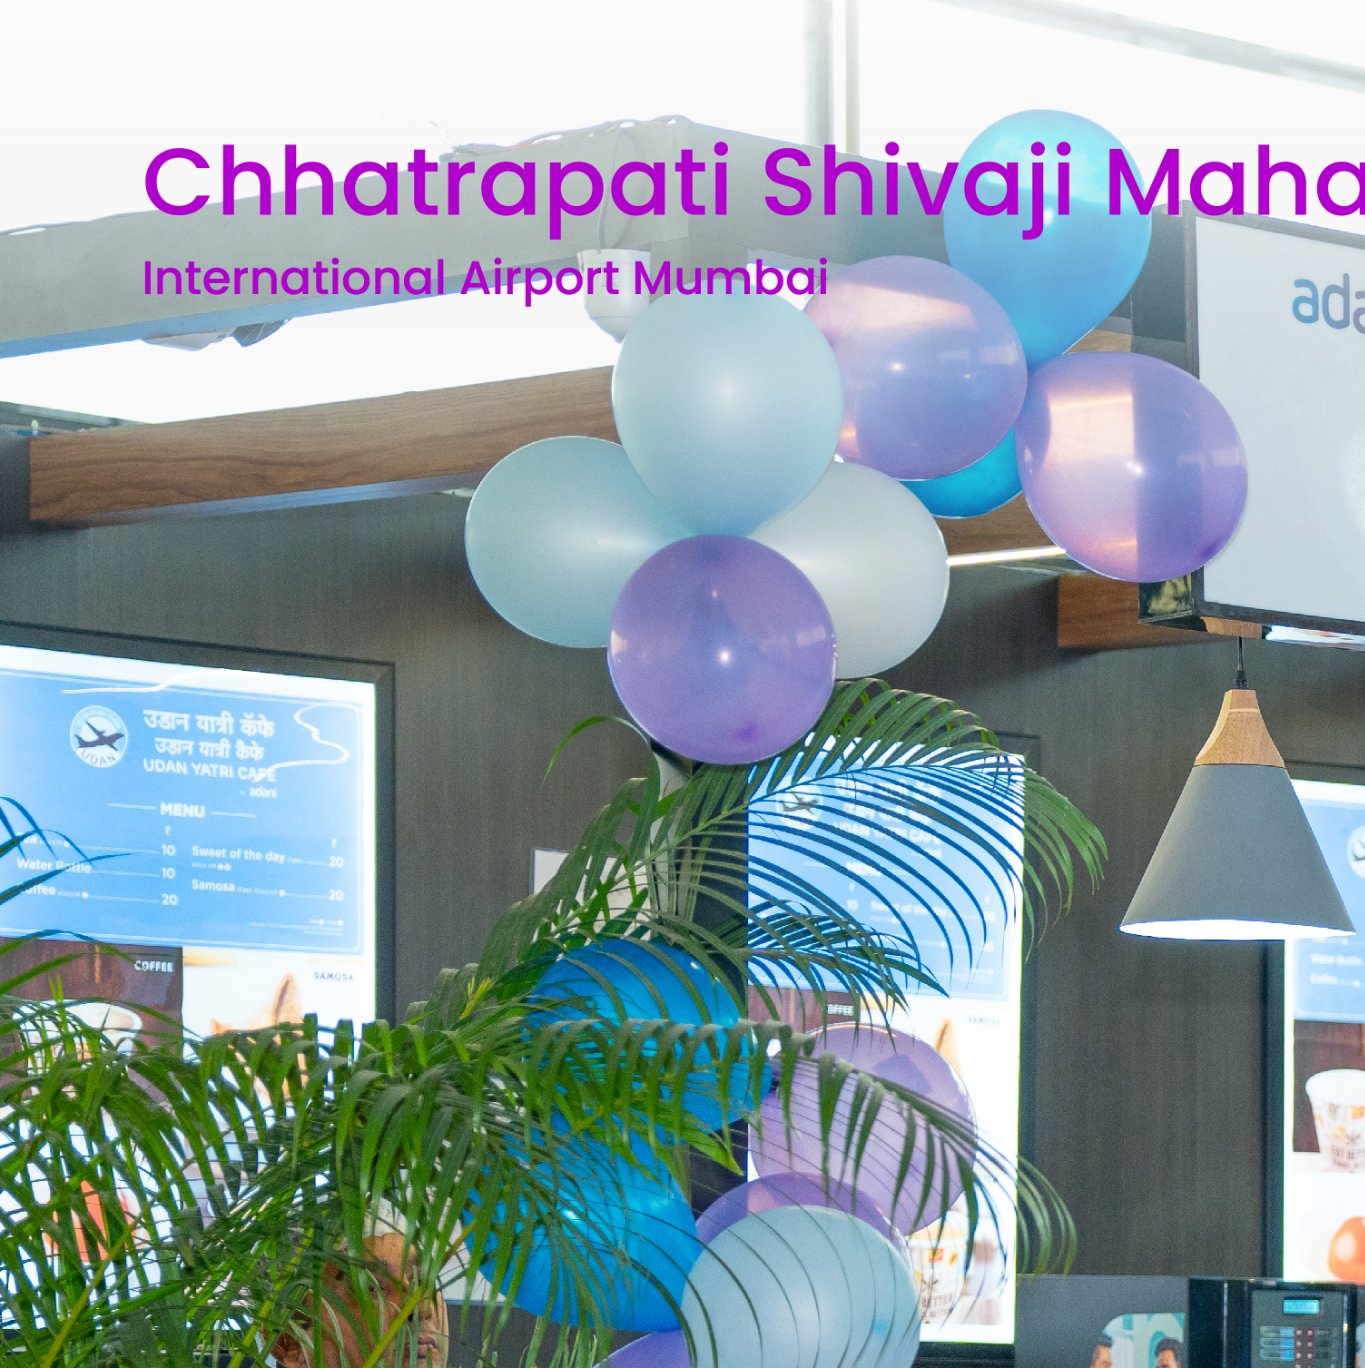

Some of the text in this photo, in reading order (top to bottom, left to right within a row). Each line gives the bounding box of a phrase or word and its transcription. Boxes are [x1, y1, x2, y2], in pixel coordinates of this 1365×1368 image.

[143, 758, 188, 776] UDAN
[191, 761, 233, 779] YATRI
[160, 801, 205, 820] MENU
[161, 845, 176, 857] 10
[191, 845, 227, 860] Sweet
[229, 846, 242, 860] of
[243, 848, 263, 862] the
[265, 850, 286, 865] day
[16, 857, 54, 872] Water
[328, 856, 345, 869] 20
[161, 867, 176, 880] 10
[191, 878, 236, 893] Samosa
[161, 894, 179, 907] 20
[328, 889, 345, 902] 20
[134, 959, 174, 973] COFFEE
[827, 1004, 855, 1016] OFFEE
